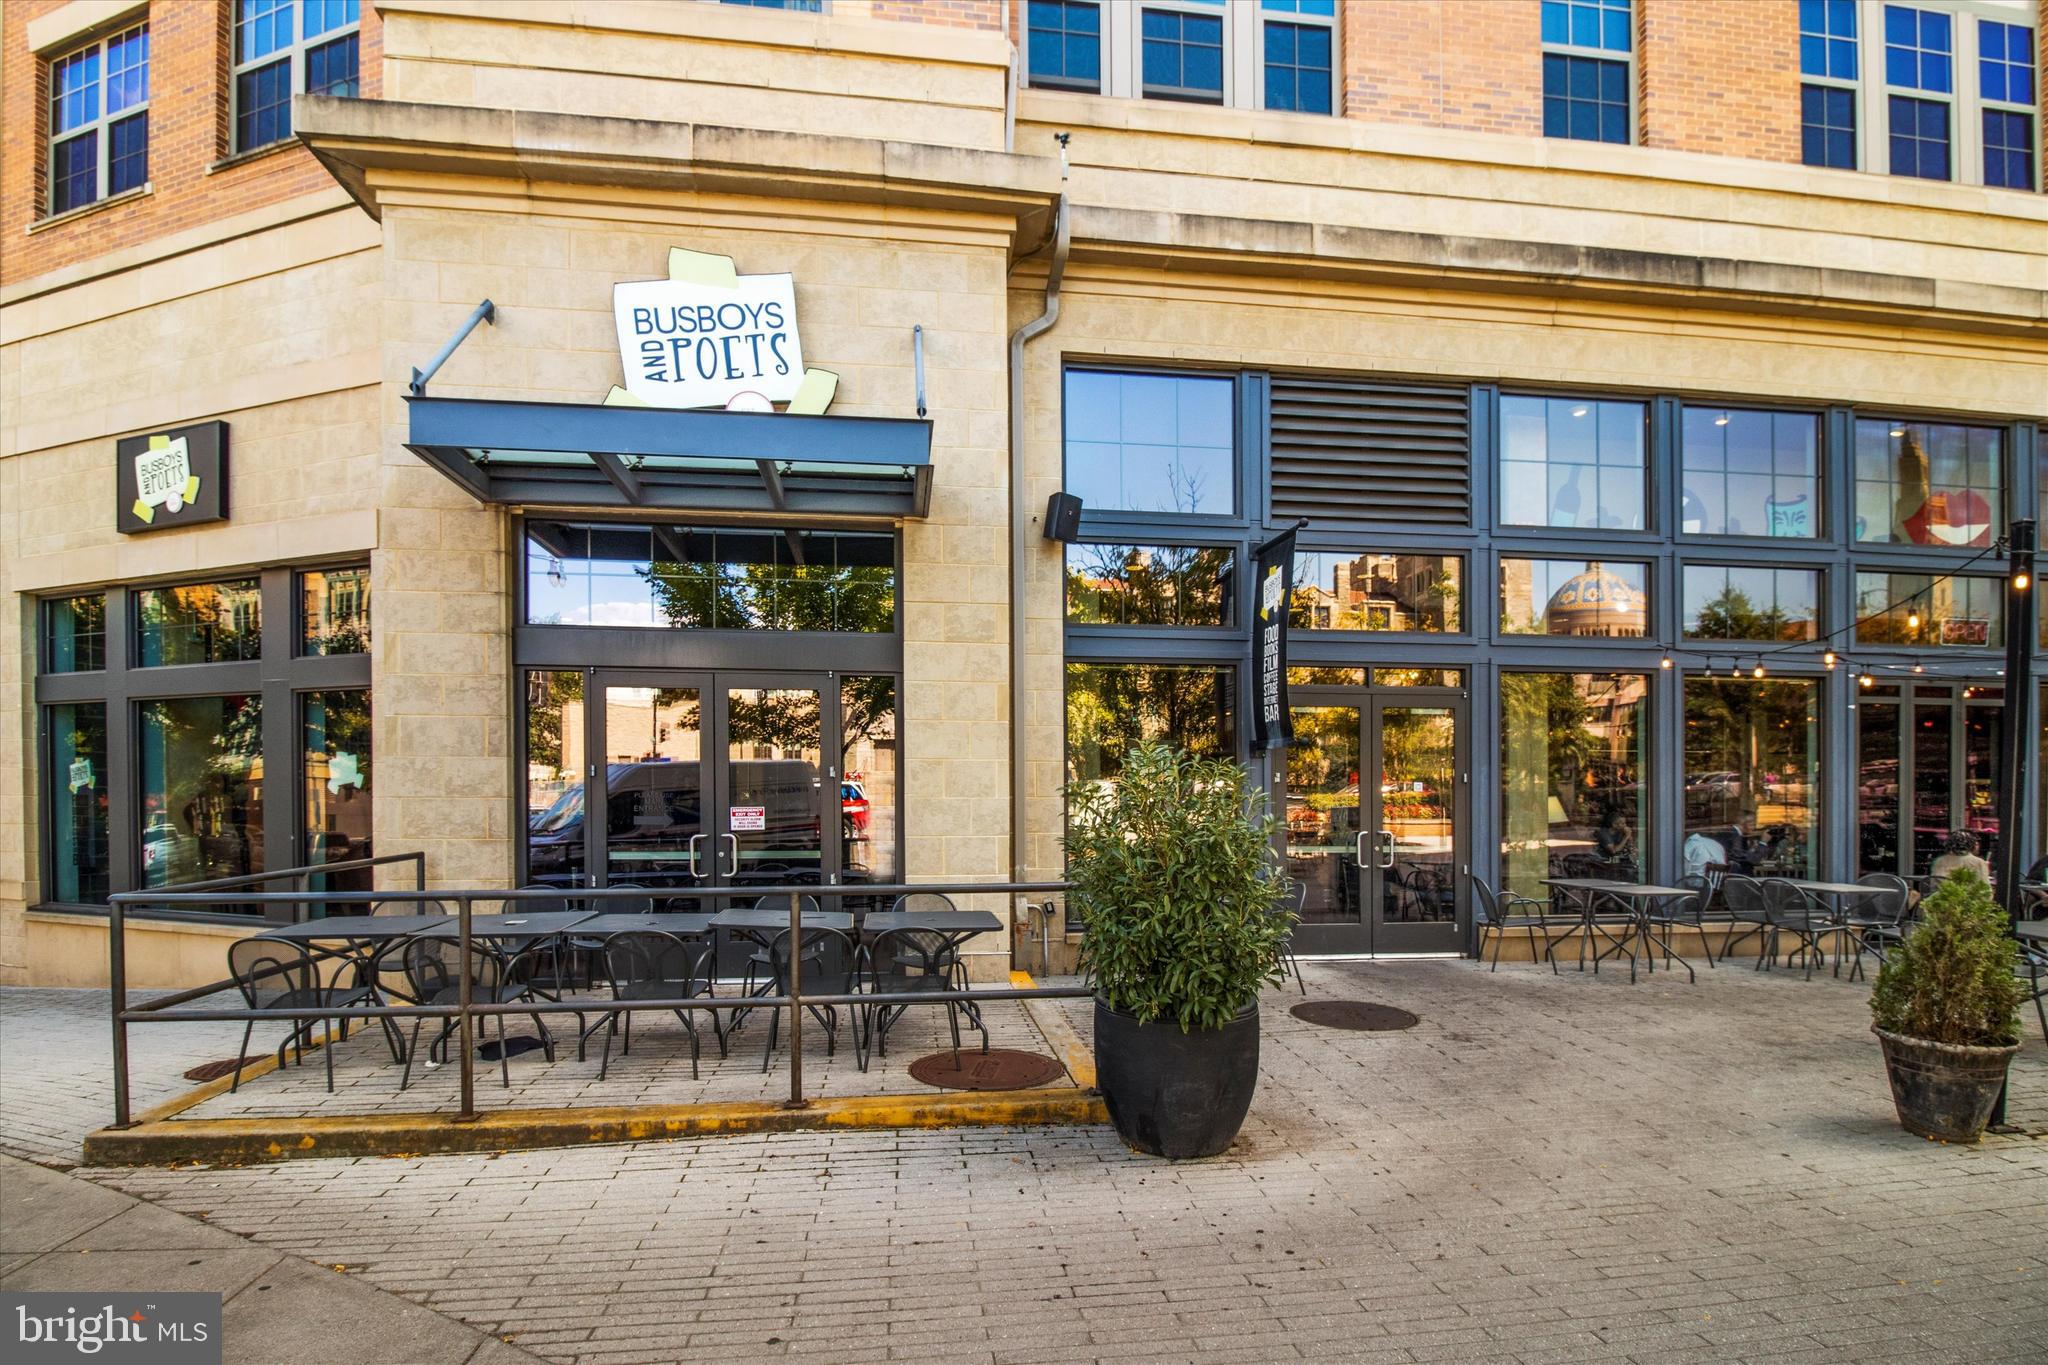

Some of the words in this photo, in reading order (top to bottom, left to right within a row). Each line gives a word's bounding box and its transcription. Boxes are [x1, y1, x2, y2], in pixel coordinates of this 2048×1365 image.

[633, 302, 785, 335] BUSBOYS
[640, 339, 669, 383] AND
[667, 332, 790, 383] POETS
[141, 450, 183, 476] BUSBOYS
[150, 464, 184, 494] POETS
[1264, 623, 1279, 645] FOOD
[1943, 623, 1987, 641] OPEN
[1263, 653, 1279, 673] FILM
[1264, 704, 1280, 722] BAR
